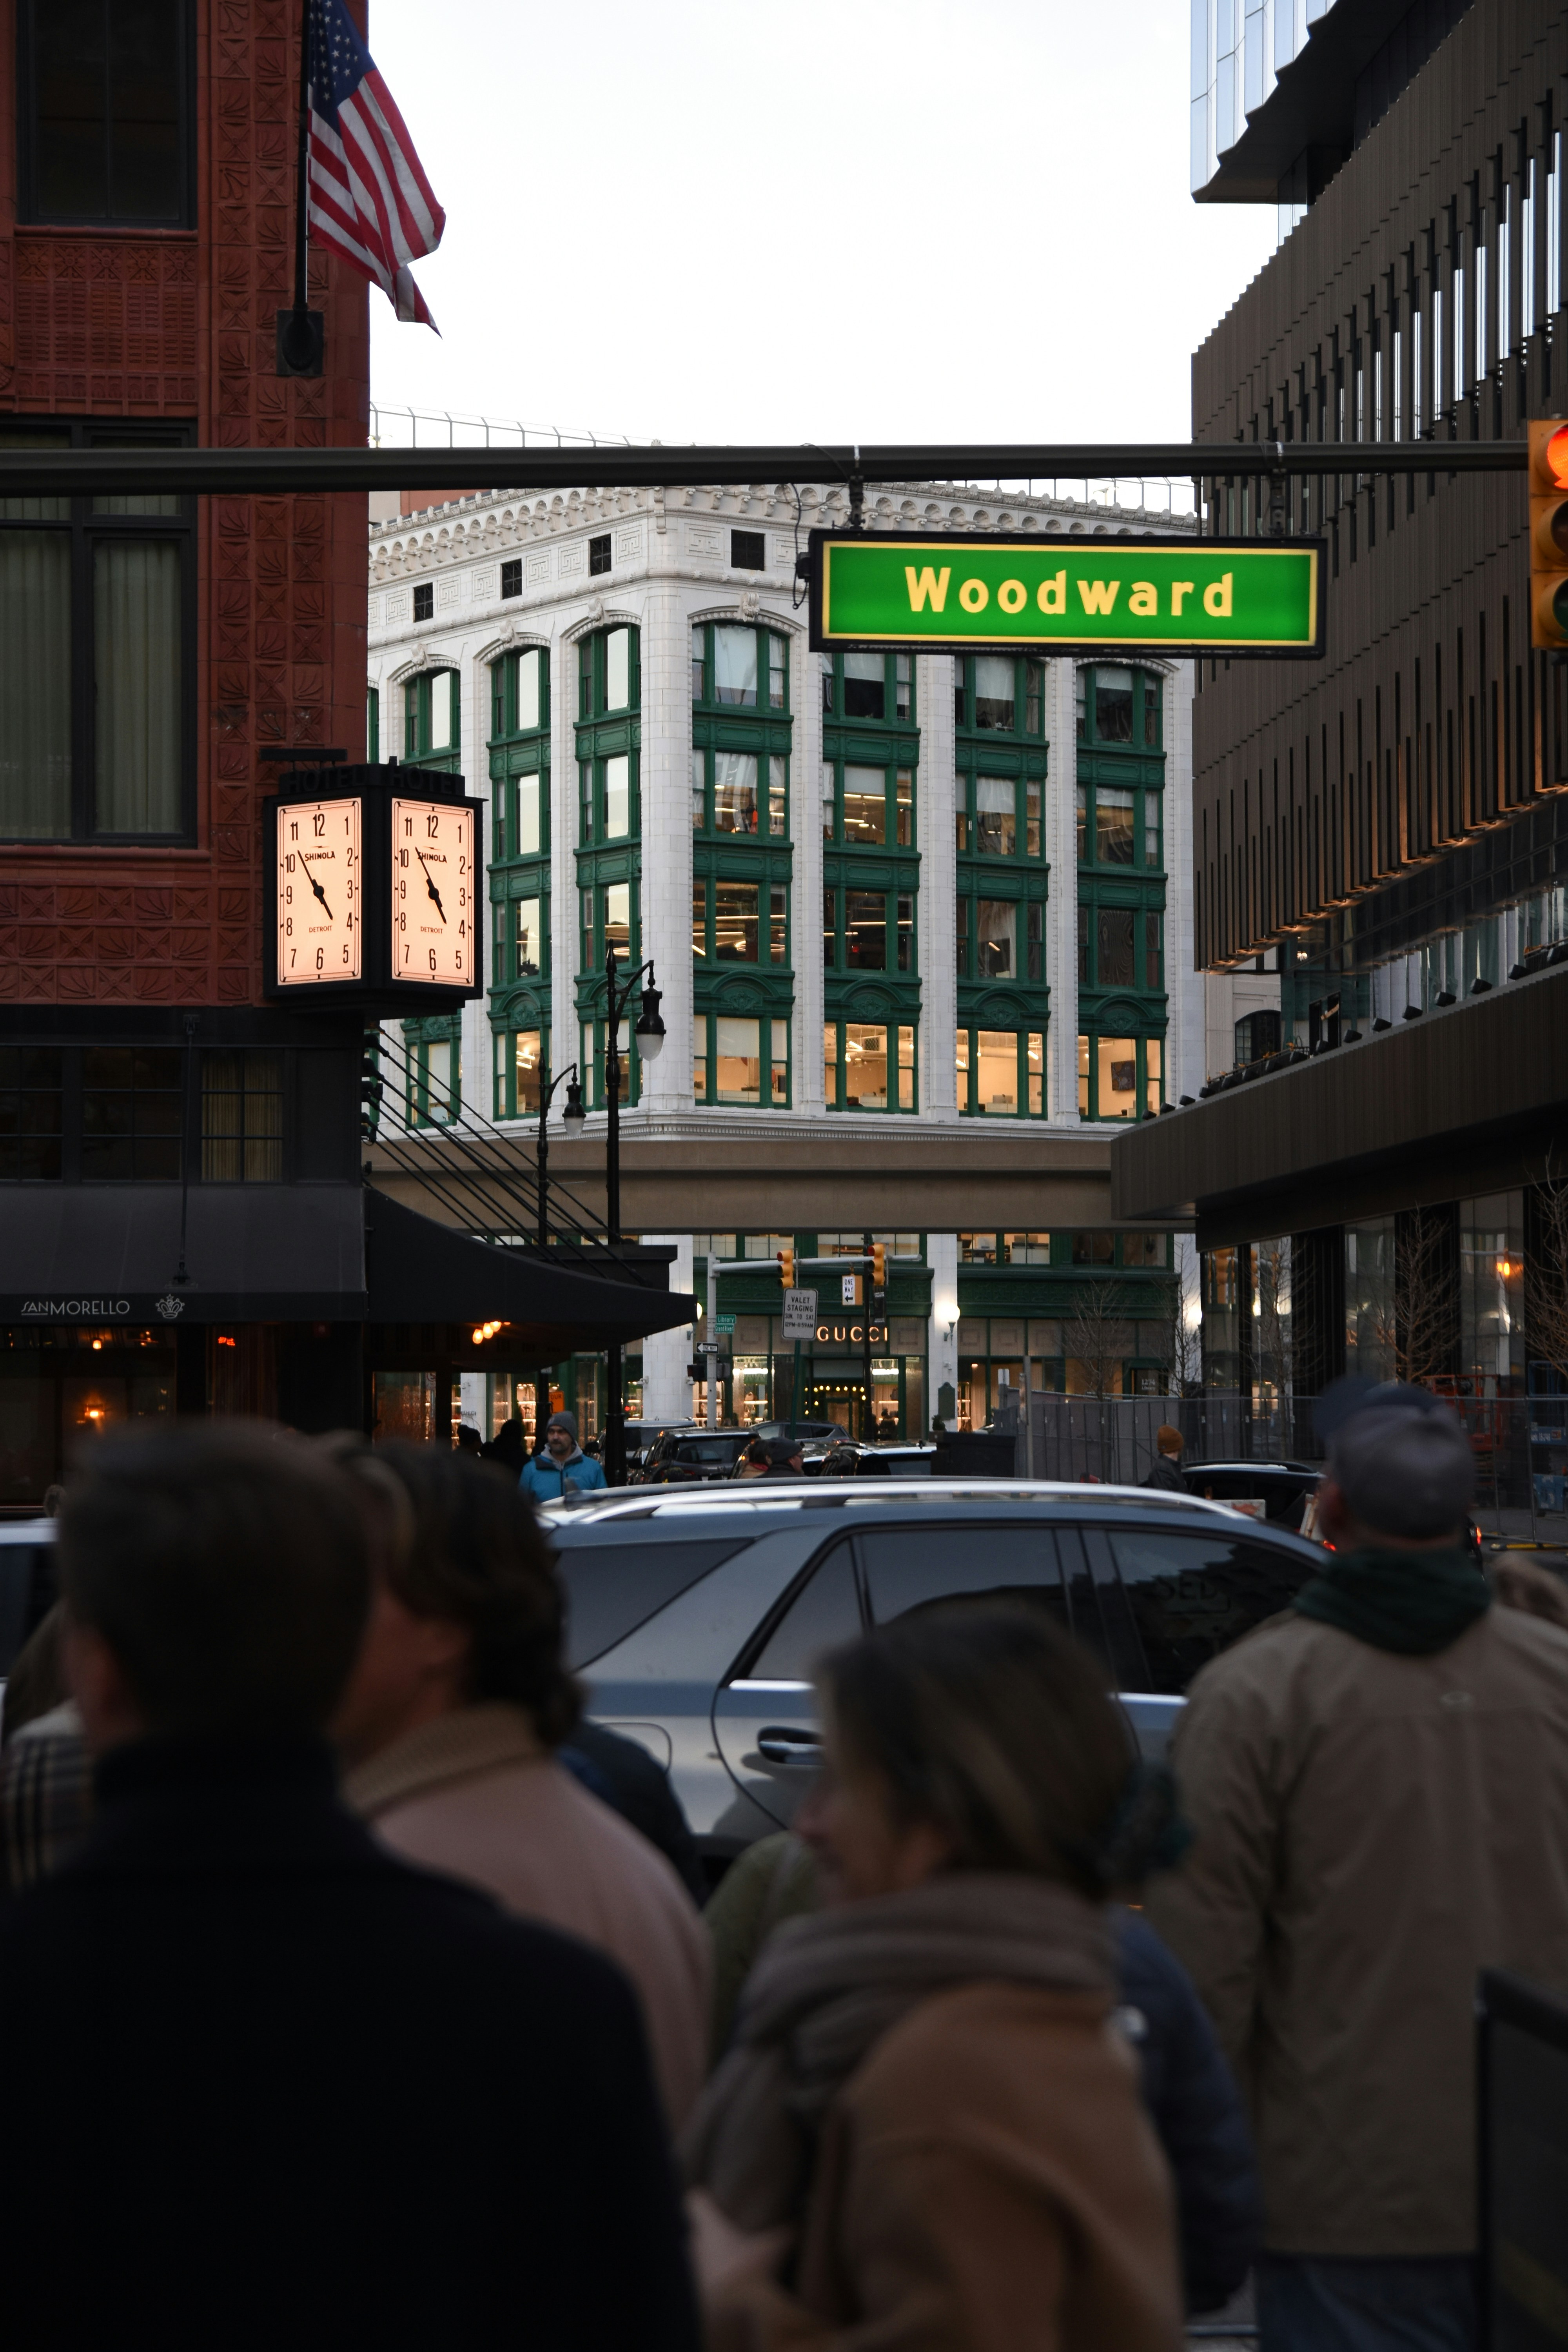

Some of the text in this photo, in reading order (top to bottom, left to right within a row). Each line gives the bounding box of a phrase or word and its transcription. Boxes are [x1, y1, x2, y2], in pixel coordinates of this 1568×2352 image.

[906, 567, 1232, 616] Woodward
[290, 821, 298, 841] 11
[312, 813, 325, 837] 12
[345, 816, 348, 835] 1
[405, 817, 412, 837] 11
[426, 815, 438, 838] 12
[457, 824, 461, 843] 1
[285, 854, 295, 873] 10
[305, 851, 336, 862] SHINOLA
[347, 848, 353, 867] 2
[399, 848, 409, 868] 10
[459, 856, 466, 875] 2
[286, 886, 292, 905] 9
[347, 880, 353, 899] 3
[400, 880, 406, 899] 9
[459, 887, 466, 906] 3
[286, 917, 292, 936] 8
[347, 912, 353, 931] 4
[400, 912, 406, 931] 8
[459, 919, 466, 938] 4
[291, 948, 297, 968] 7
[316, 947, 323, 970] 6
[343, 944, 348, 964] 5
[405, 944, 410, 964] 7
[429, 948, 436, 971] 6
[456, 950, 462, 969] 5
[787, 1304, 813, 1312] STAGING
[817, 1326, 888, 1341] GUCCI
